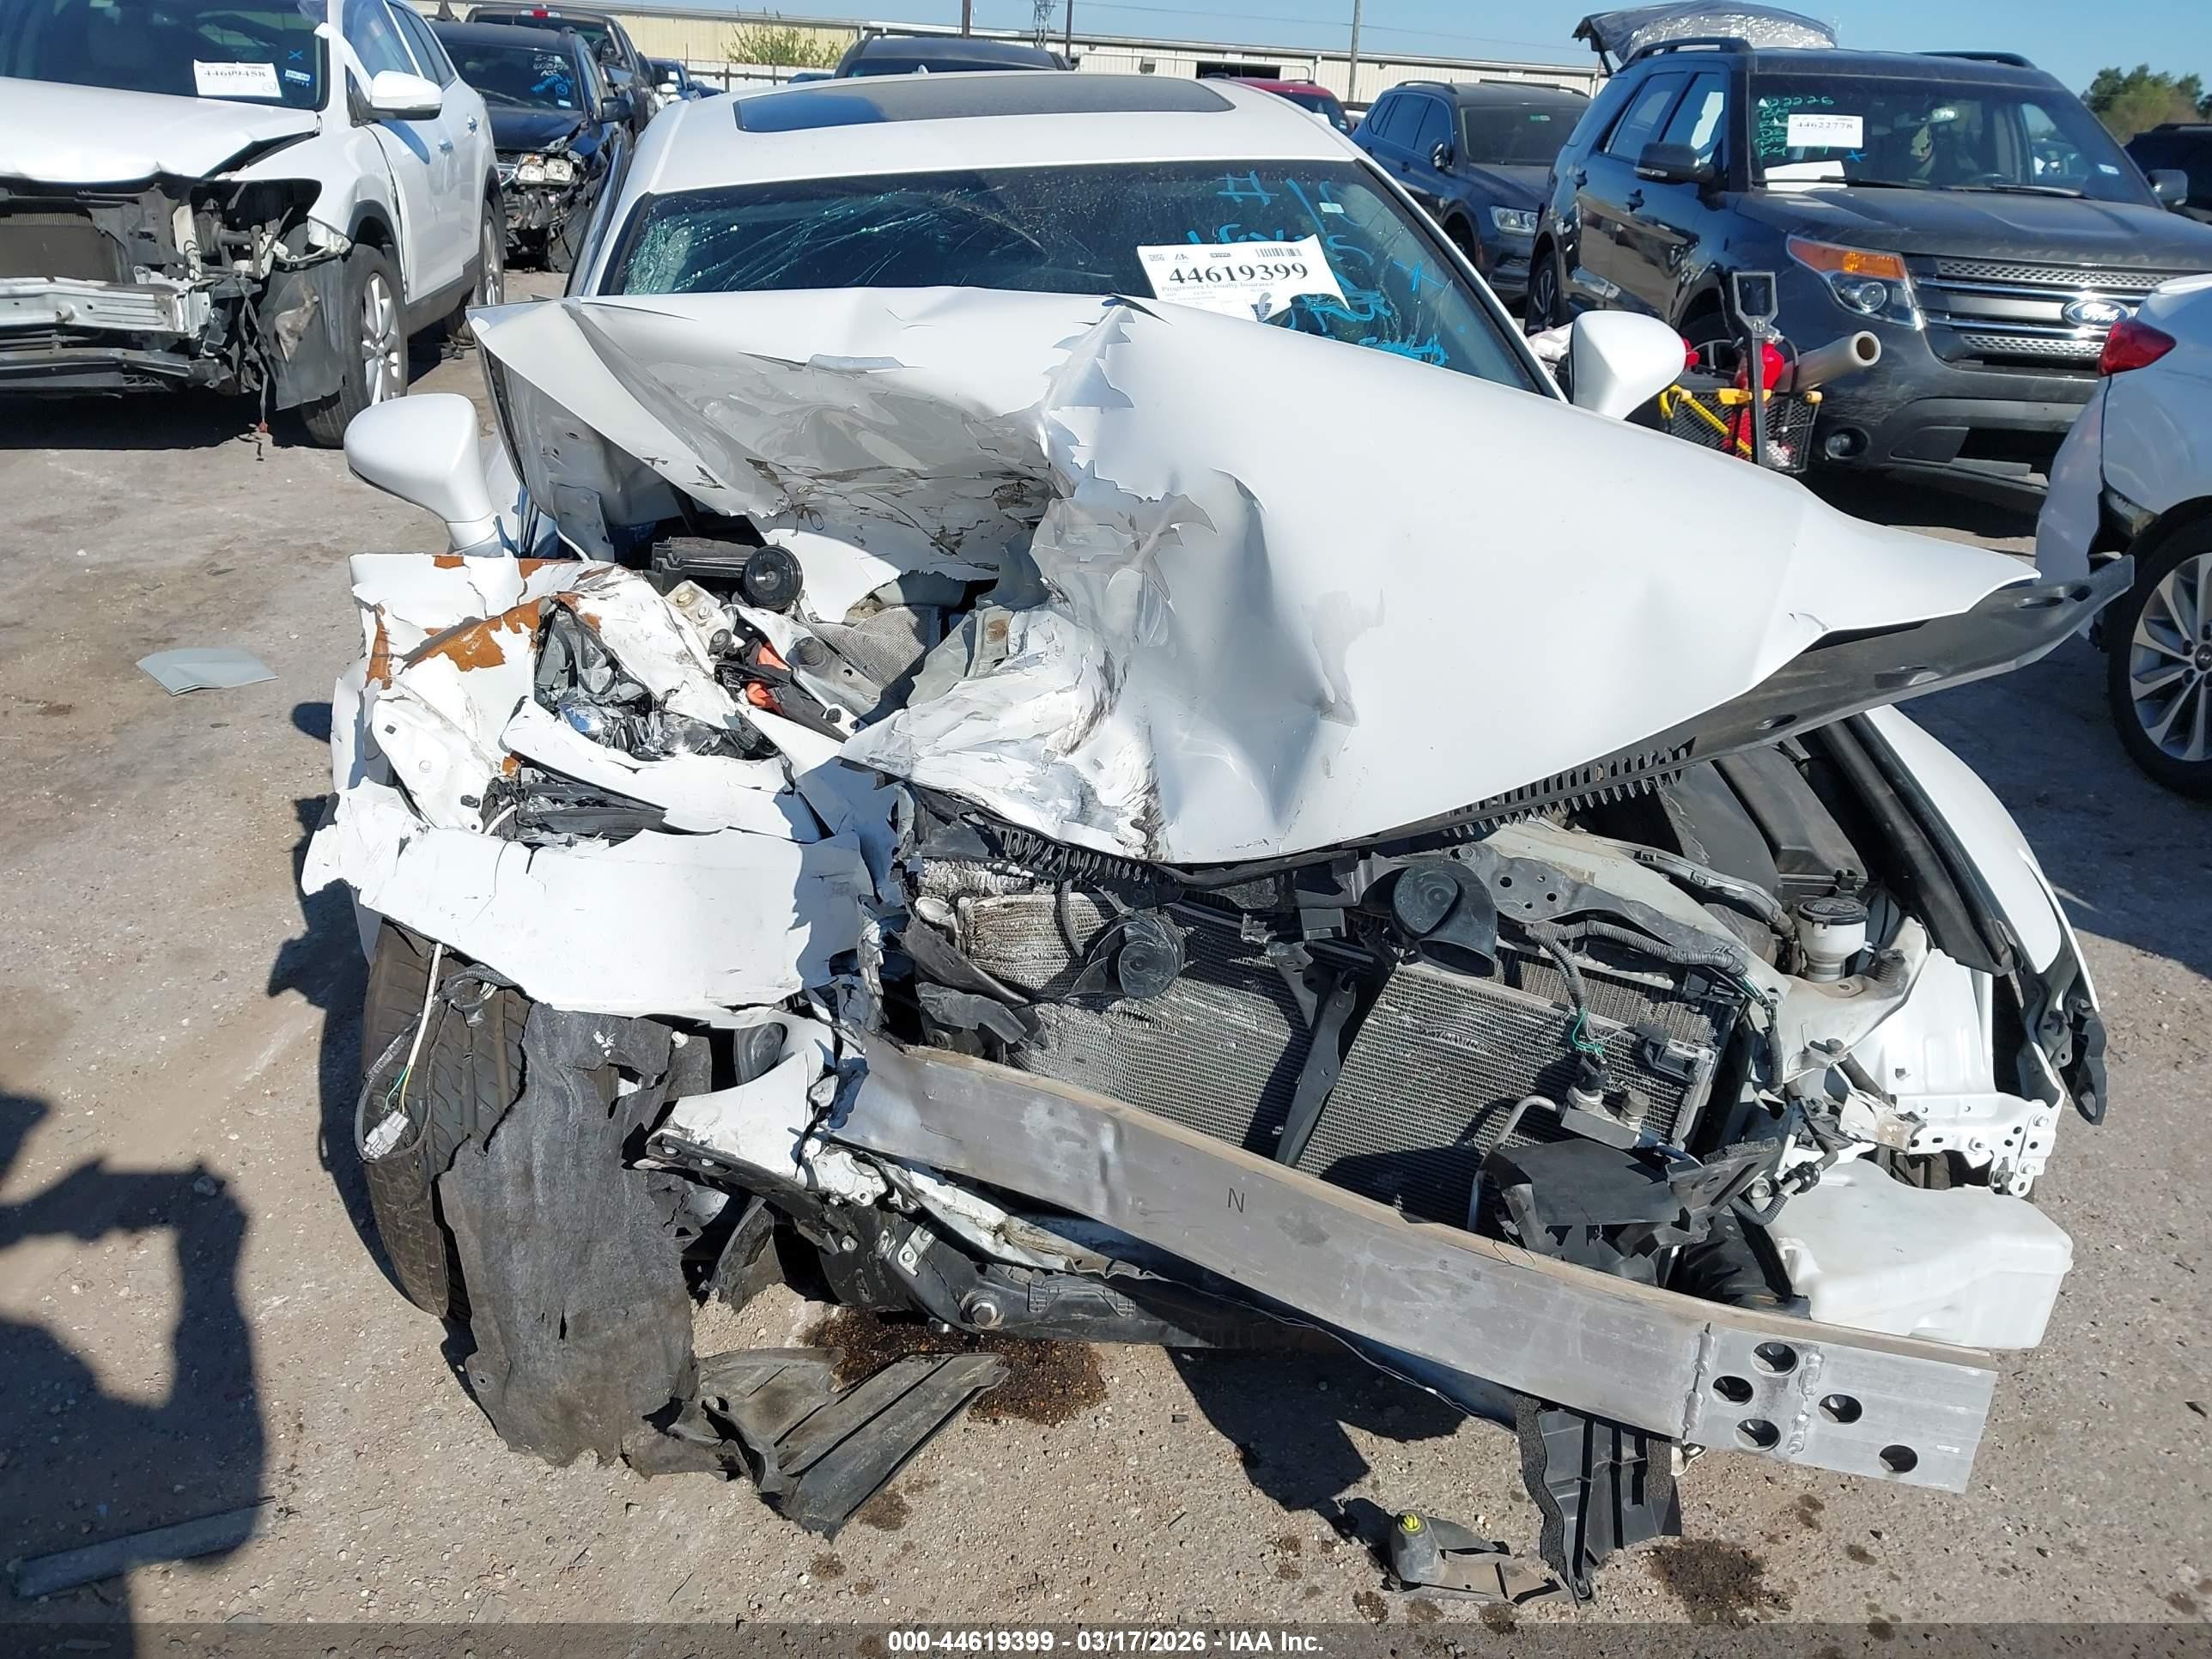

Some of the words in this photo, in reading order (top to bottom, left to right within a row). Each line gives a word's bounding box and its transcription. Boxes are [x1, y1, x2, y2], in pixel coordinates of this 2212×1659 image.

[1169, 262, 1309, 284] 44619399
[1161, 284, 1204, 293] Progressive
[1228, 1188, 1244, 1212] N
